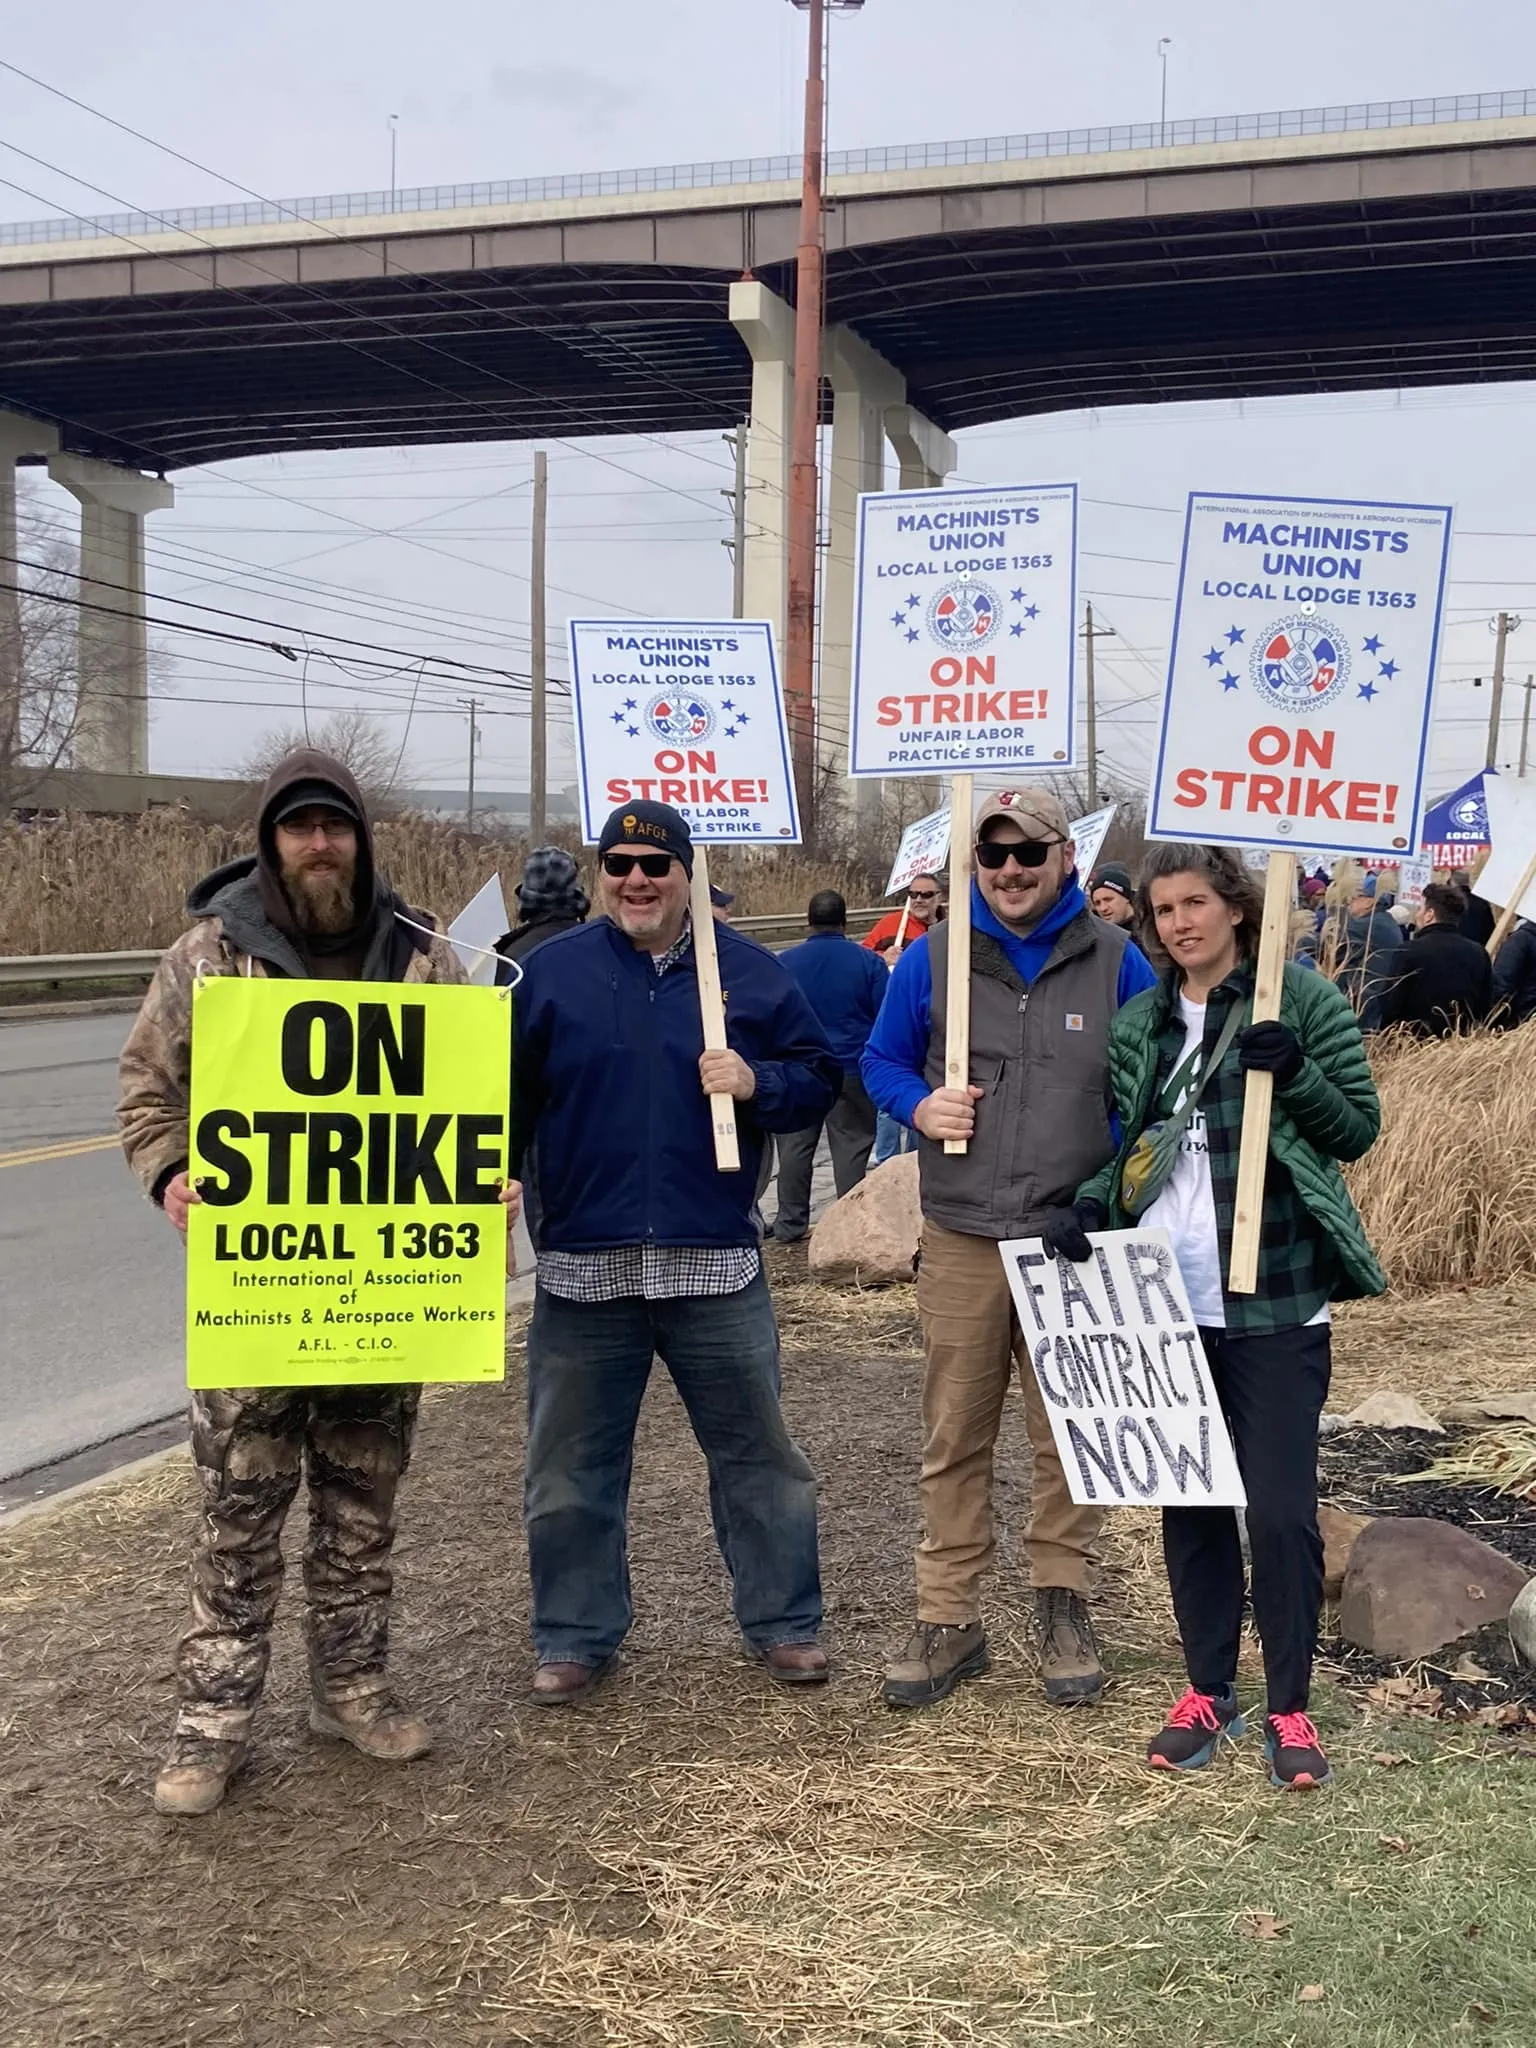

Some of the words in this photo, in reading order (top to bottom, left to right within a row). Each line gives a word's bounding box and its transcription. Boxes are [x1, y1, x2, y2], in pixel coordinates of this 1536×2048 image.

[897, 507, 1039, 532] MACHINISTS
[929, 531, 1005, 551] UNION
[1223, 521, 1409, 553] MACHINISTS
[877, 562, 938, 577] LOCAL
[944, 557, 1006, 574] LODGE
[1011, 555, 1053, 569] 1363
[1262, 553, 1361, 580] UNION
[1203, 580, 1277, 600] LOCAL
[1284, 584, 1361, 605] LODGE
[1368, 590, 1417, 609] 1363
[607, 637, 739, 651] MACHINISTS
[639, 654, 710, 668] UNION
[929, 655, 995, 687] ON
[592, 674, 650, 685] LOCAL
[655, 674, 714, 685] LODGE
[718, 675, 756, 686] 1363
[876, 689, 1048, 726] STRIKE!
[899, 729, 961, 743] UNFAIR
[967, 727, 1024, 740] LABOR
[888, 747, 970, 762] PRACTICE
[975, 745, 1035, 759] STRIKE
[1248, 725, 1335, 770] ON
[654, 750, 717, 774] ON
[606, 779, 769, 803] STRIKE!
[1173, 768, 1400, 824] STRIKE!
[696, 808, 750, 818] LABOR
[637, 822, 668, 842] AFGE
[706, 823, 761, 832] STRIKE
[1446, 832, 1486, 840] LOCAL
[910, 854, 929, 869] ON
[281, 1000, 426, 1096] ON
[195, 1109, 505, 1206] STRIKE
[215, 1223, 355, 1262] LOCAL
[377, 1222, 480, 1260] 1363
[233, 1270, 353, 1287] International
[364, 1269, 462, 1286] Association
[1016, 1242, 1187, 1331] FAIR
[339, 1289, 358, 1305] of
[195, 1310, 291, 1327] Machinists
[301, 1309, 312, 1325] &
[323, 1308, 414, 1328] Aerospace
[423, 1307, 496, 1323] Workers
[298, 1338, 337, 1351] A.F.L.
[356, 1337, 397, 1350] C.I.O.
[1035, 1330, 1207, 1409] CONTRACT
[1066, 1415, 1213, 1499] NOW
